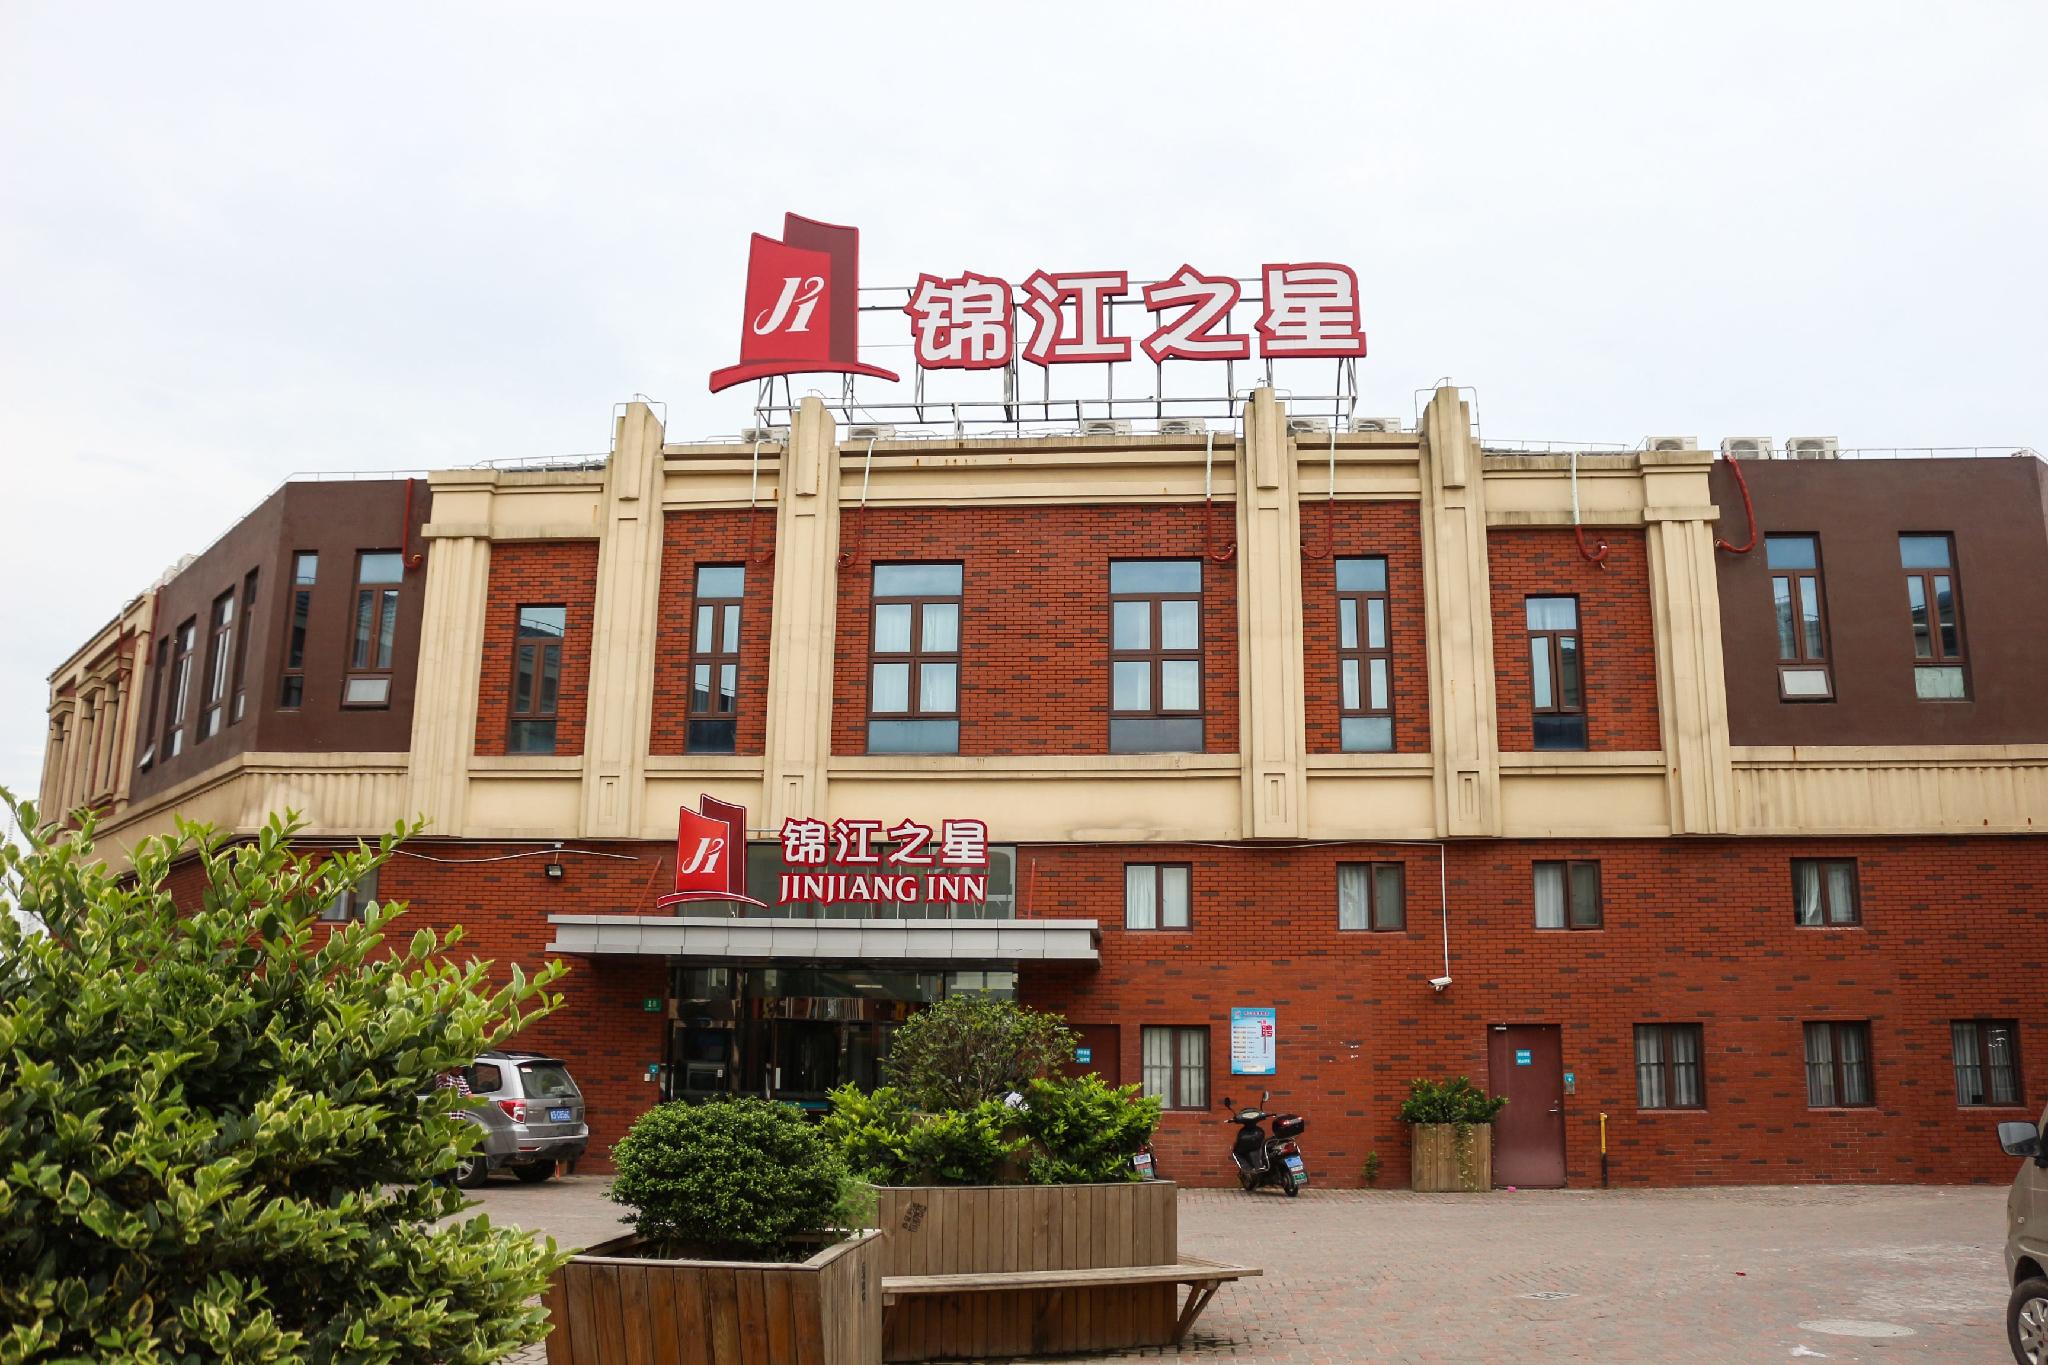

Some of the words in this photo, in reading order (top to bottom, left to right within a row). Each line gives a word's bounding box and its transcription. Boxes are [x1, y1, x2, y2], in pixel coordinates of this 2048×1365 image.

[910, 265, 1364, 366] 锦江之星
[781, 819, 987, 866] 锦江之星
[779, 875, 917, 903] JINJIANG
[925, 876, 986, 901] INN
